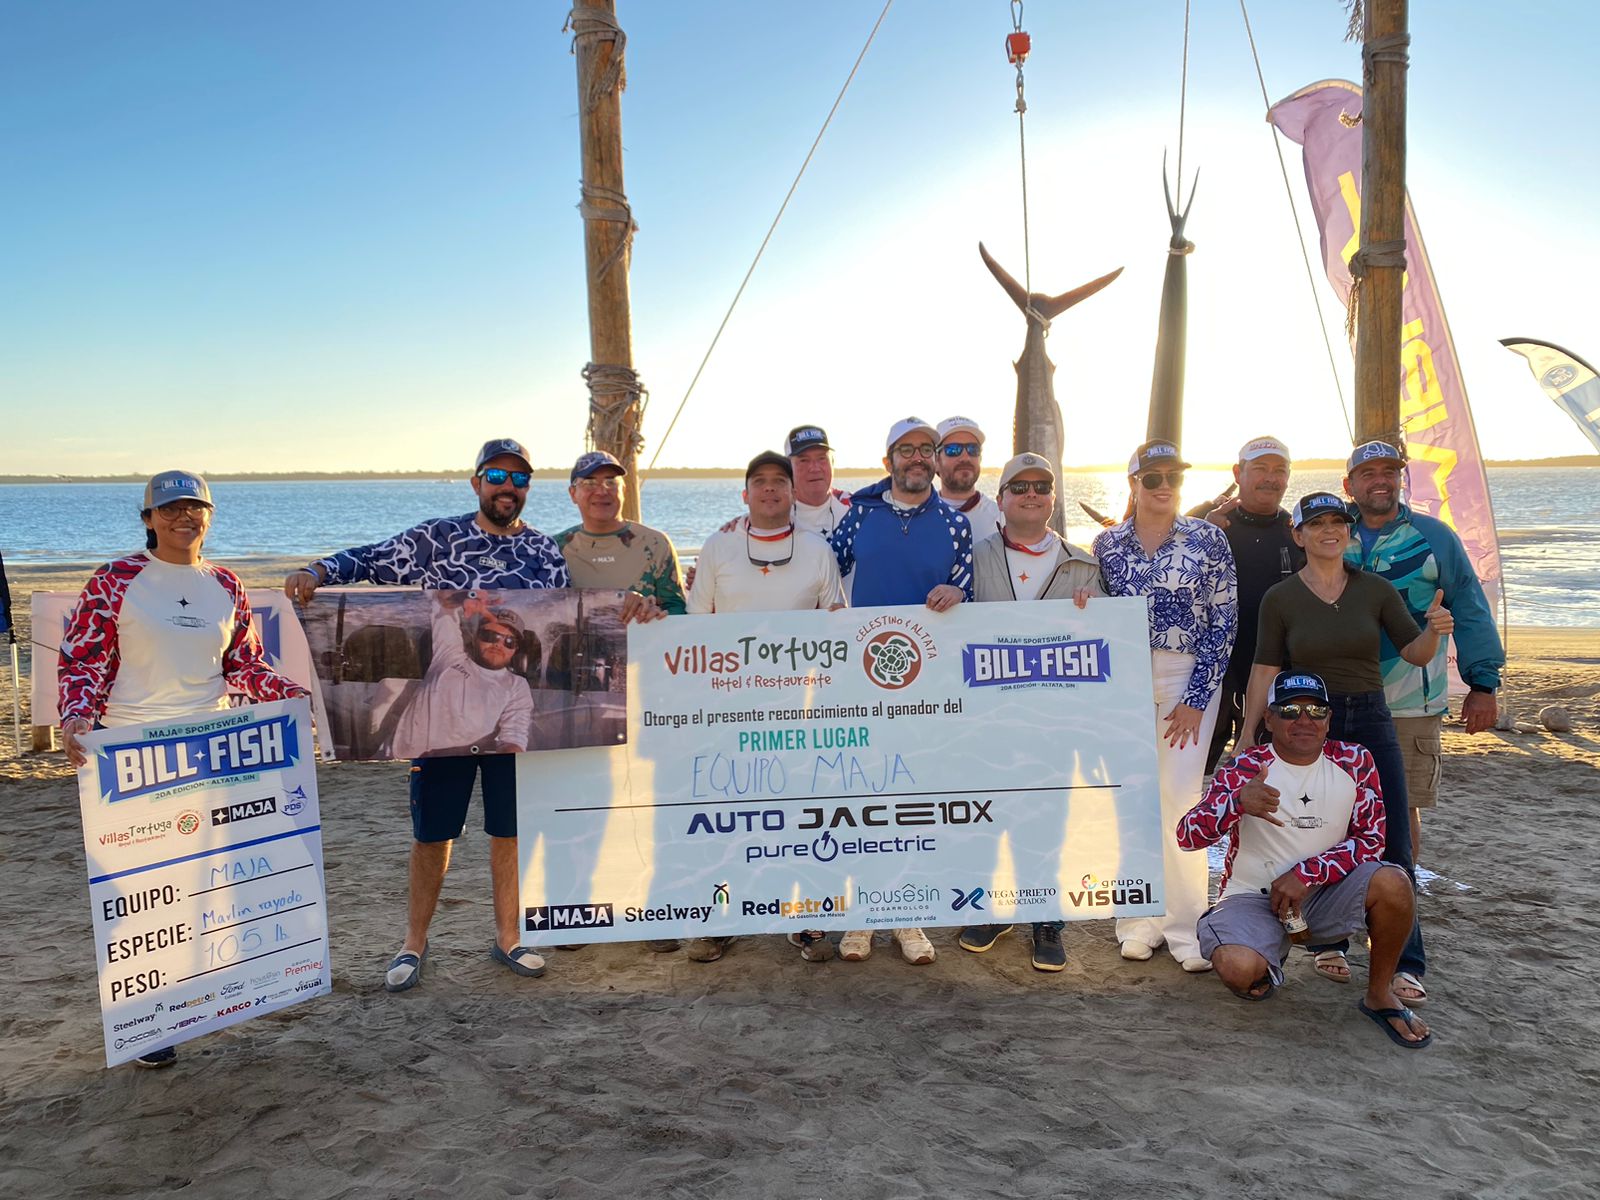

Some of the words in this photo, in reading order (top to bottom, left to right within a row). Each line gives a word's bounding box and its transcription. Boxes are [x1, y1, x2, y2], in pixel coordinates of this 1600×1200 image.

[855, 615, 903, 643] CELESTINO
[911, 623, 938, 660] ALTATA
[1023, 634, 1072, 645] SPORTSWEAR
[974, 648, 1032, 681] BILL
[1040, 643, 1099, 677] FISH
[711, 675, 742, 692] Hotel
[754, 674, 832, 690] Restaurante
[644, 711, 688, 728] Otorga
[692, 708, 703, 724] el
[708, 709, 765, 726] presente
[768, 704, 868, 721] reconocimiento
[872, 701, 883, 717] al
[887, 699, 940, 719] ganador
[943, 698, 963, 714] del
[185, 714, 249, 735] SPORTSWEAR
[739, 729, 806, 752] PRIMER
[813, 726, 870, 749] LUGAR
[115, 742, 198, 793] BILL
[208, 721, 284, 771] FISH
[692, 752, 787, 798] EQUIPO
[811, 751, 916, 793] MAJA
[154, 791, 171, 799] 2DA
[231, 799, 275, 819] MAJA
[284, 802, 301, 811] PDS
[686, 810, 785, 835] AUTO
[746, 842, 809, 863] pure
[842, 835, 936, 854] electric
[210, 857, 273, 887] MAJA
[1102, 878, 1144, 889] grupo
[103, 884, 181, 921] EQUIPO:
[1005, 897, 1047, 906] ASOCIADOS
[1068, 883, 1151, 907] visual
[553, 905, 609, 927] MAJA
[624, 903, 713, 923] Steelway
[865, 916, 894, 924] Espacios
[107, 923, 193, 964] ESPECIE:
[204, 927, 263, 967] 105
[285, 960, 324, 977] Premier
[111, 969, 167, 1002] PESO:
[220, 981, 246, 996] Ford
[294, 978, 323, 992] visual
[113, 1013, 156, 1032] Steelway
